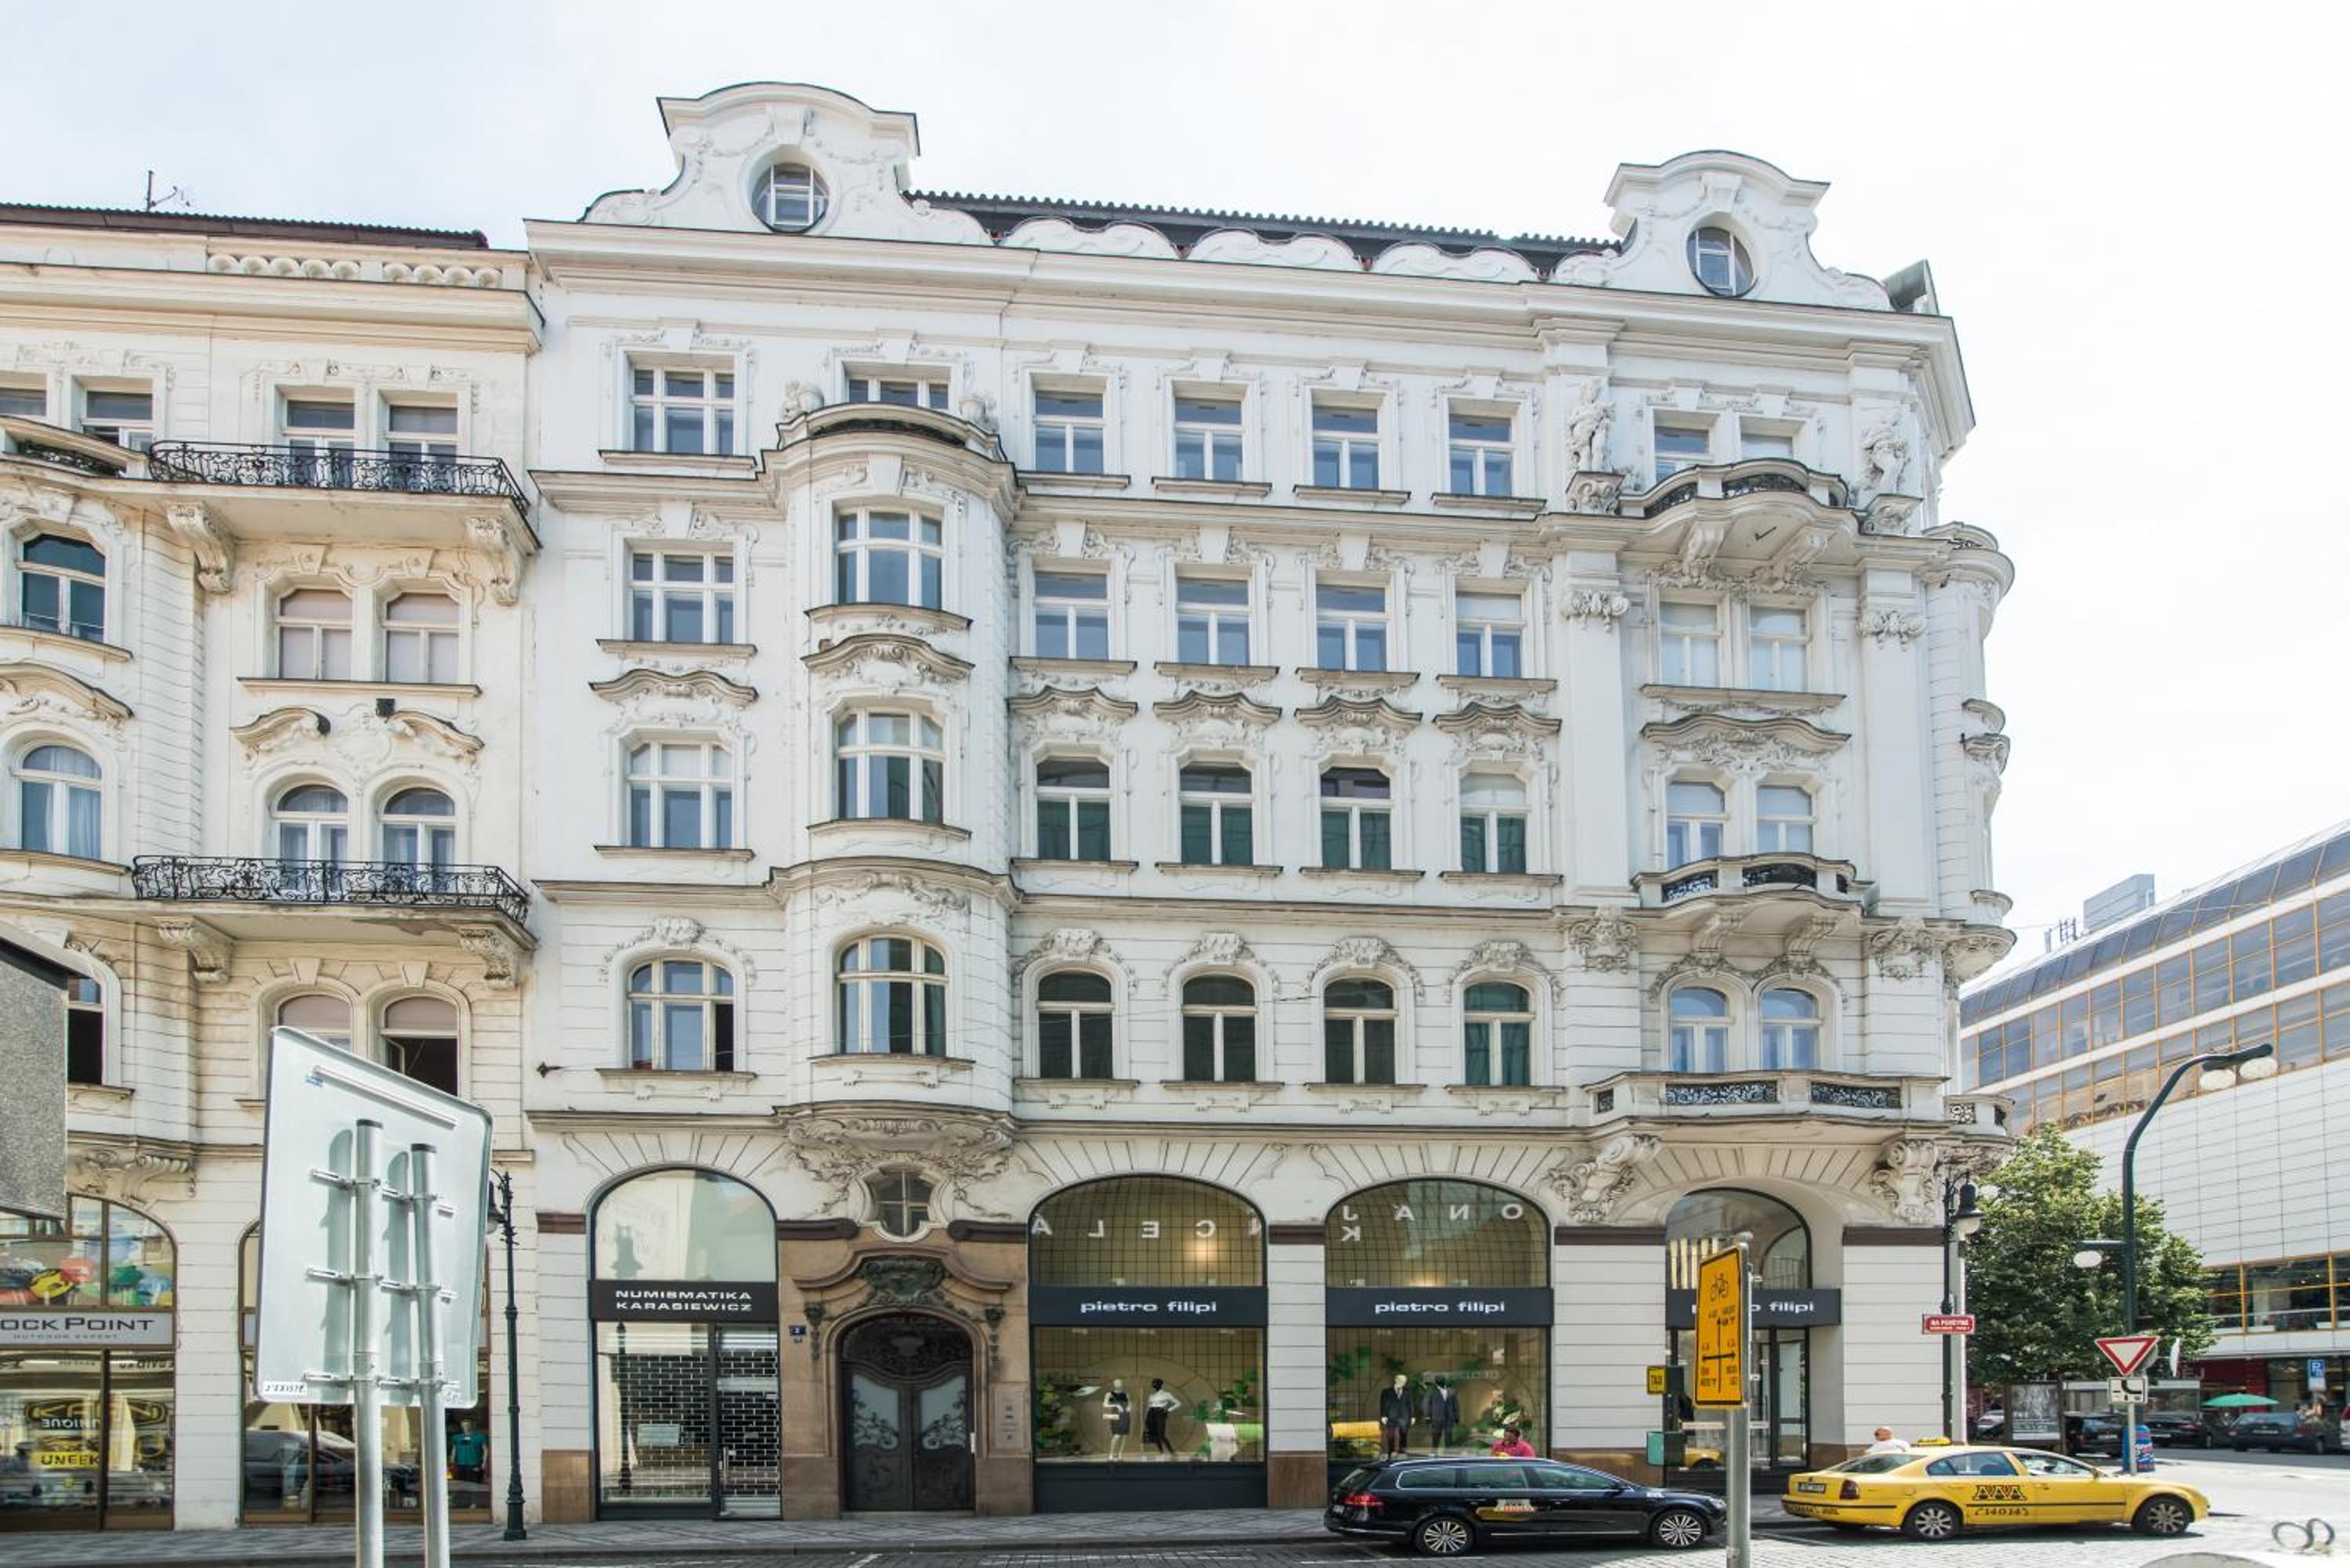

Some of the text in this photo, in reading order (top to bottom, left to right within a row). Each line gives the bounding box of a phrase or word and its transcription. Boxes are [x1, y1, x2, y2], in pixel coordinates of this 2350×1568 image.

[615, 1290, 752, 1300] NUMISMATIKA
[616, 1302, 753, 1312] KARASIEWICZ
[1080, 1300, 1217, 1313] pietro filipi
[1375, 1301, 1506, 1314] pietro filipi
[1769, 1301, 1814, 1313] filipi
[64, 1317, 155, 1331] POINT
